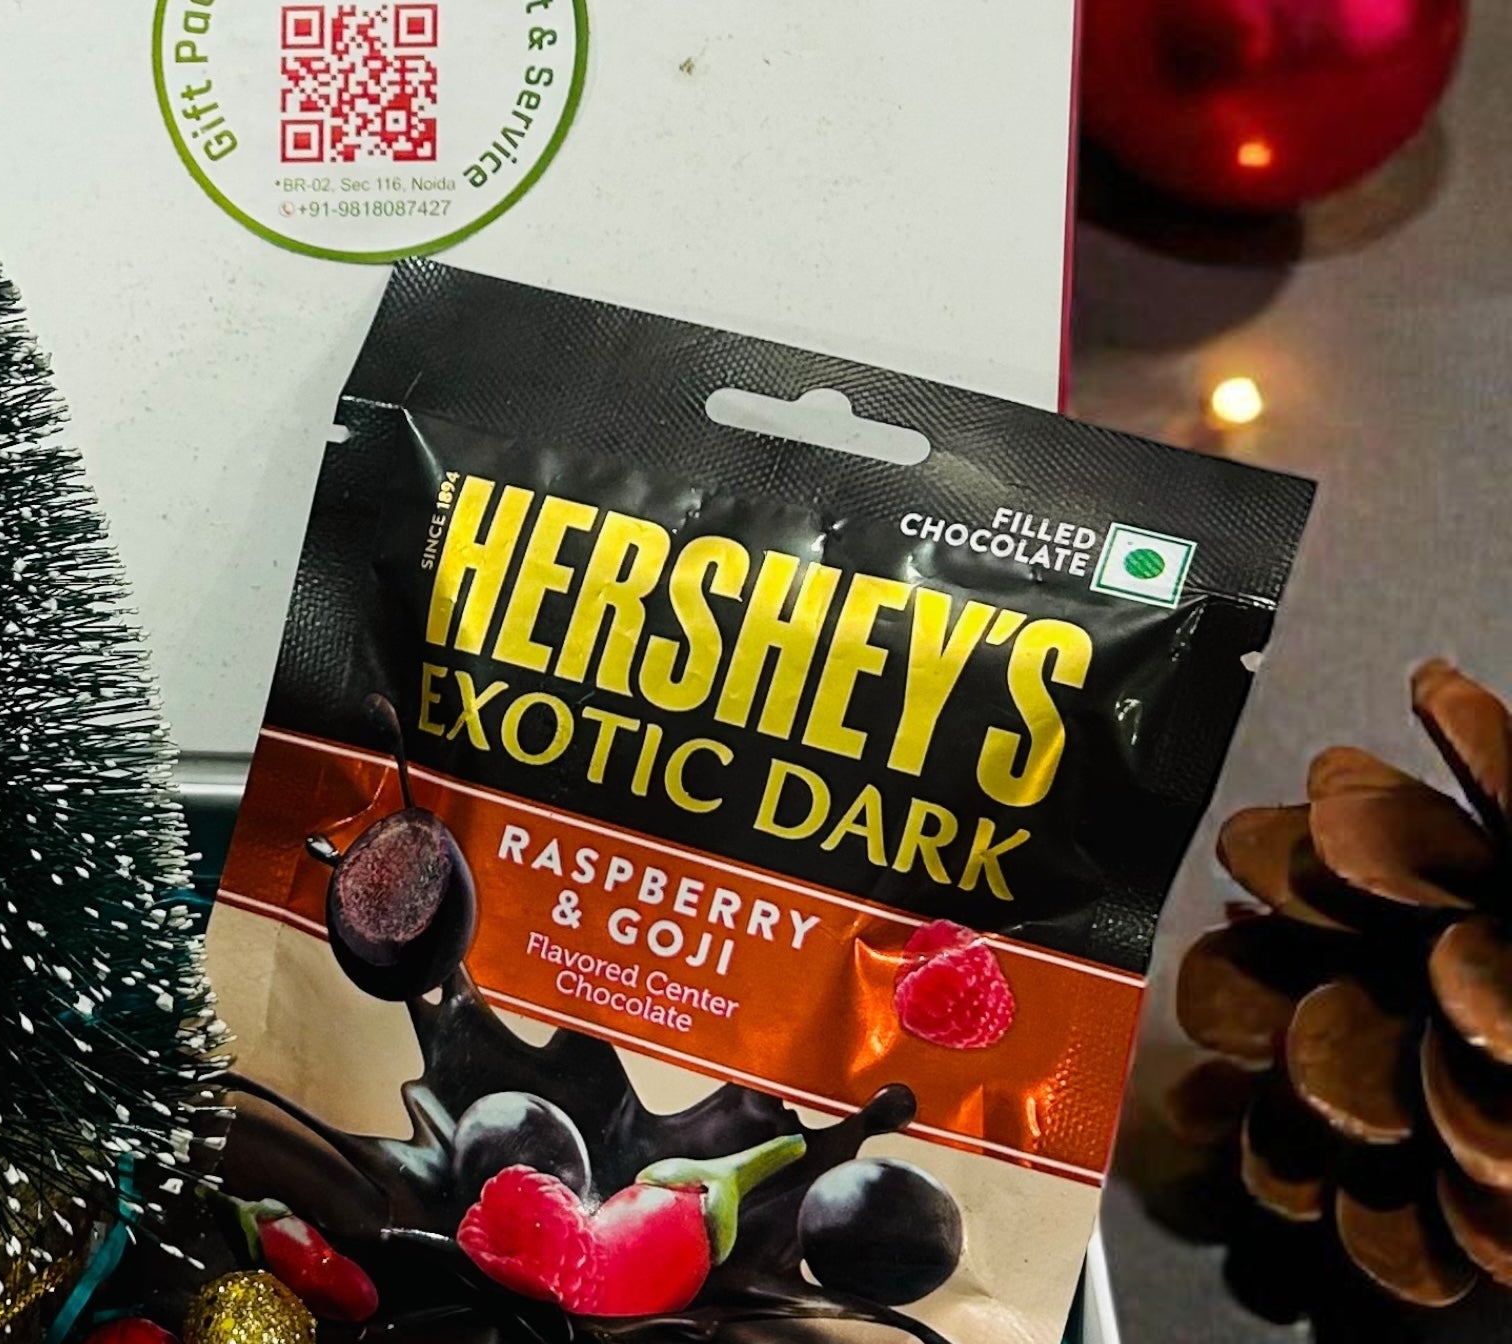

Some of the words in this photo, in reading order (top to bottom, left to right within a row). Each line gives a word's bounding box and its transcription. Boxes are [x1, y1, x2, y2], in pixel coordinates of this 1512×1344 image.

[527, 26, 558, 51] &
[180, 79, 239, 163] Gift
[462, 64, 555, 189] Service
[297, 200, 452, 218] +91-9818087427
[340, 177, 371, 192] Sec
[376, 176, 406, 193] 116,
[411, 176, 457, 192] Noida
[420, 513, 447, 571] SINCE
[436, 471, 461, 510] 1894
[899, 512, 1091, 577] CHOCOLATE
[991, 506, 1097, 551] FILLED
[423, 473, 1094, 809] HERSHEY'S
[417, 663, 736, 816] EXOTIC
[753, 759, 1032, 903] DARK
[497, 823, 822, 950] RASPBERRY
[525, 931, 640, 989] Flavored
[645, 970, 741, 1019] Center
[551, 888, 583, 929] &
[607, 907, 735, 976] GOJI
[555, 969, 693, 1033] Chocolate
